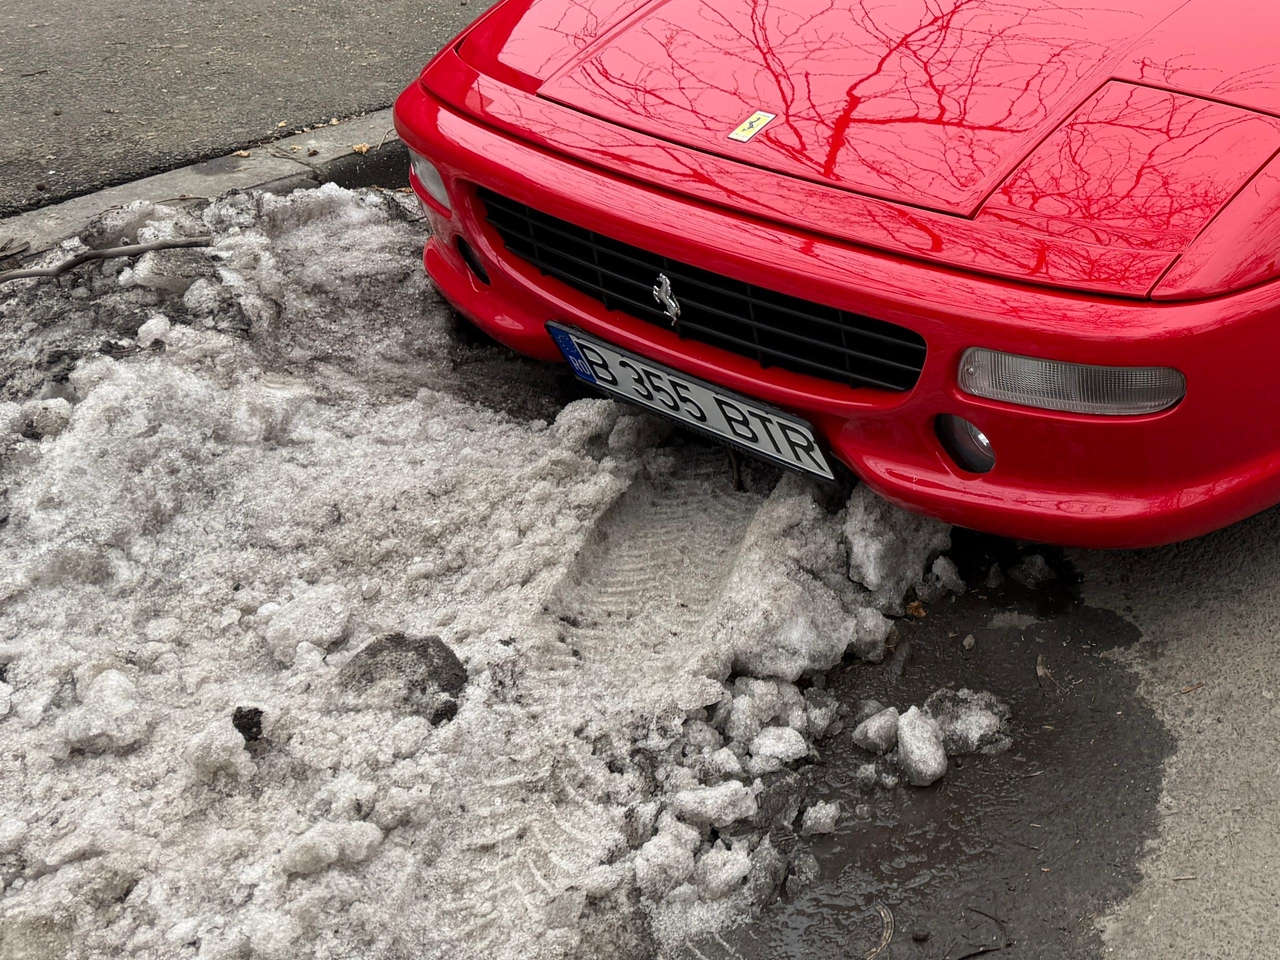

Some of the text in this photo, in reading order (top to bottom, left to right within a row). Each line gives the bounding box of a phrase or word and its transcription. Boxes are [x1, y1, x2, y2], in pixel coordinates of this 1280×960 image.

[568, 355, 591, 375] RO
[575, 342, 618, 386] B
[619, 360, 707, 423] 355
[712, 396, 827, 473] BTR
